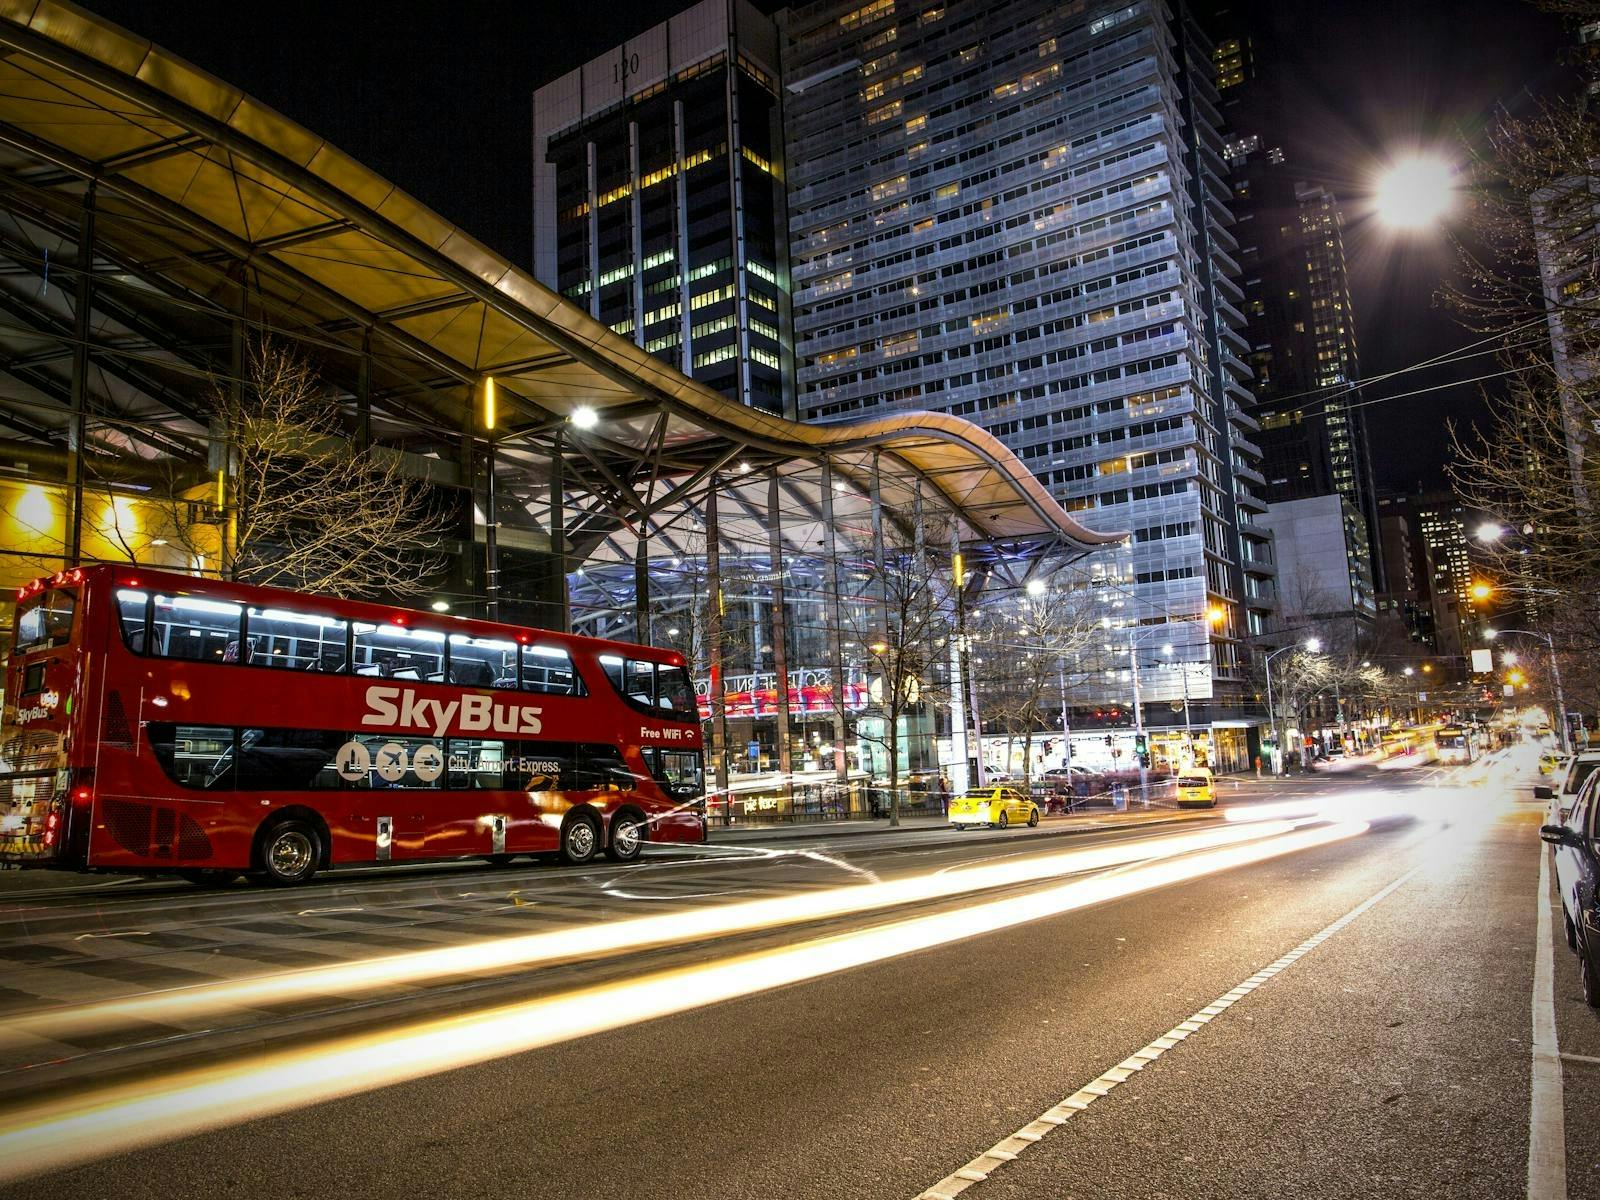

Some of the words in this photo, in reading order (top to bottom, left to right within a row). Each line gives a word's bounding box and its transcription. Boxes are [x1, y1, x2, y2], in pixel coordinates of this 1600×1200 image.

[614, 53, 639, 84] 120
[16, 706, 49, 725] SkyBus
[362, 686, 543, 737] SkyBus
[640, 726, 660, 739] Free
[662, 728, 682, 740] WiFi
[519, 757, 561, 775] Express.
